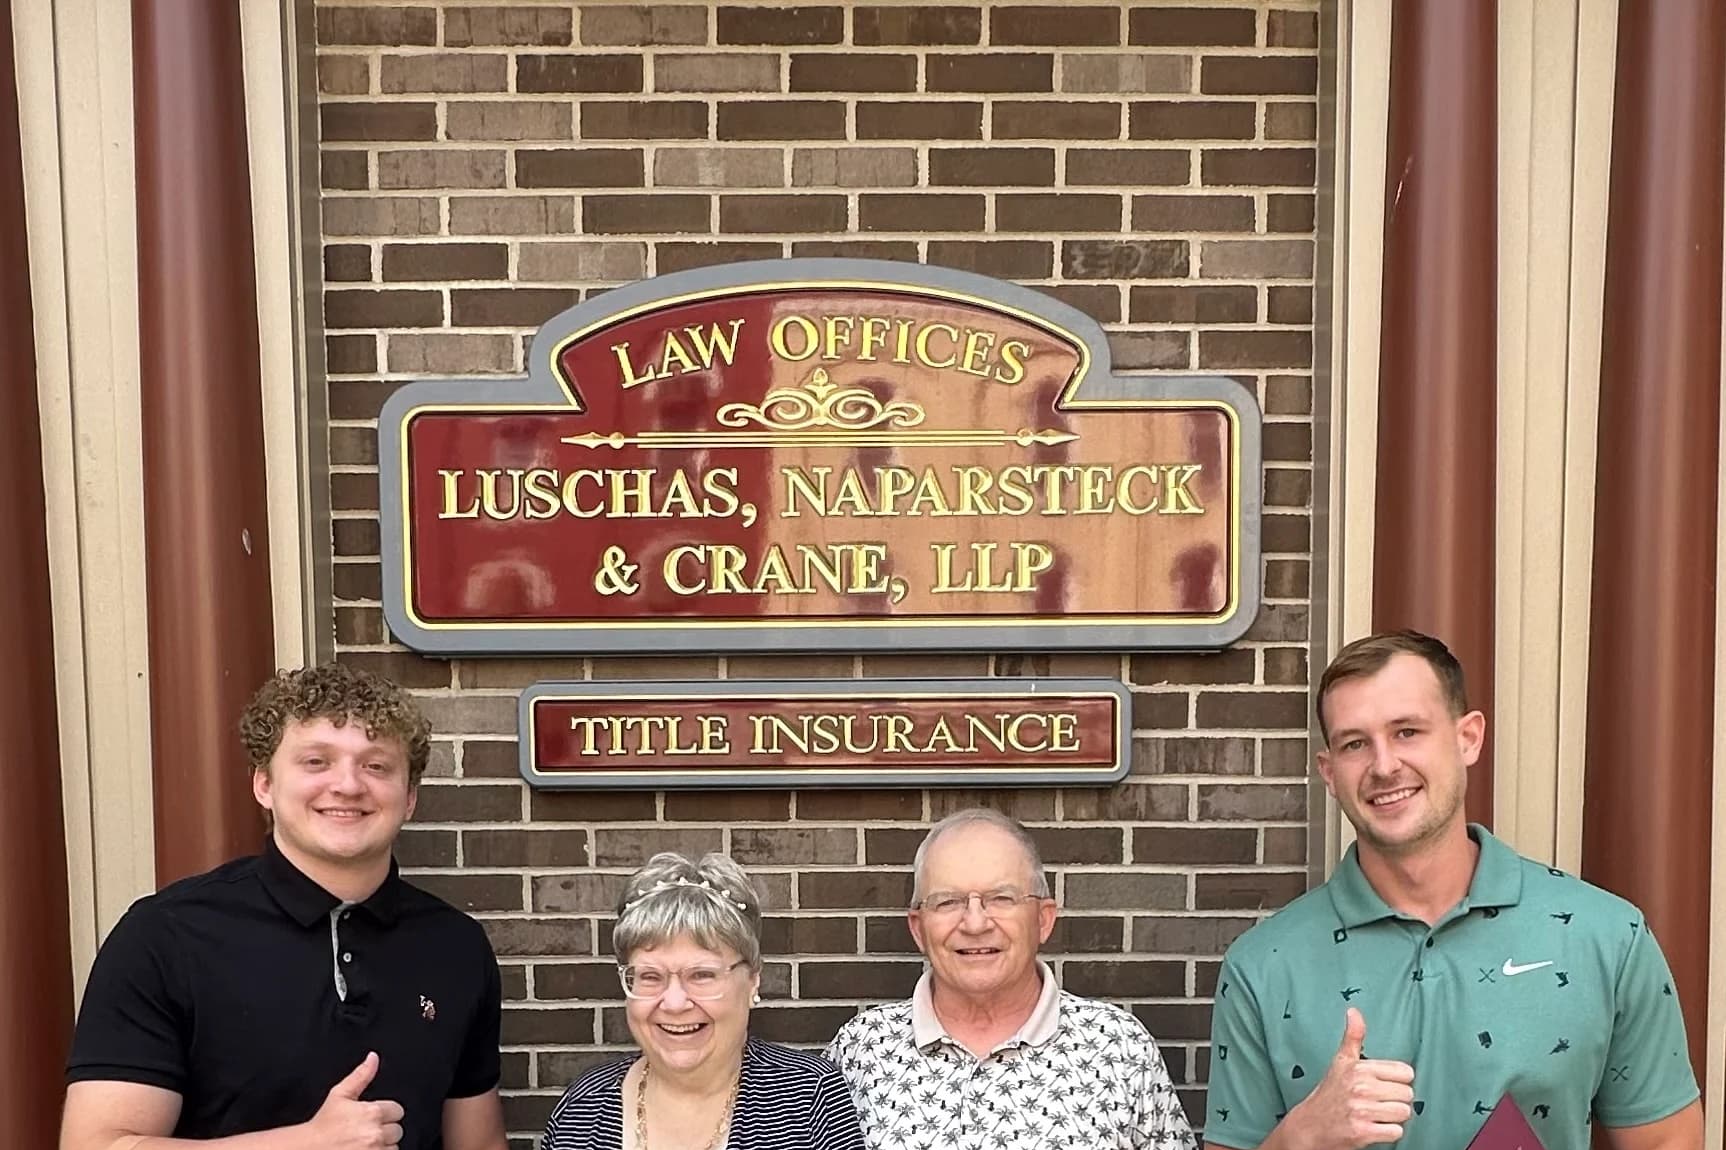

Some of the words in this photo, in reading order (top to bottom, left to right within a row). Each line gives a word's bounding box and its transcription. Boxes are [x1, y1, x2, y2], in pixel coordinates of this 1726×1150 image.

[611, 319, 745, 389] LAW
[771, 315, 1031, 384] OFFICES
[438, 468, 758, 528] LUSCHAS,
[781, 464, 1205, 518] NAPARSTECK
[594, 545, 641, 595] &
[663, 544, 908, 603] CRANE,
[930, 543, 1053, 594] LLP
[571, 715, 730, 756] TITLE
[749, 714, 1081, 755] INSURANCE
